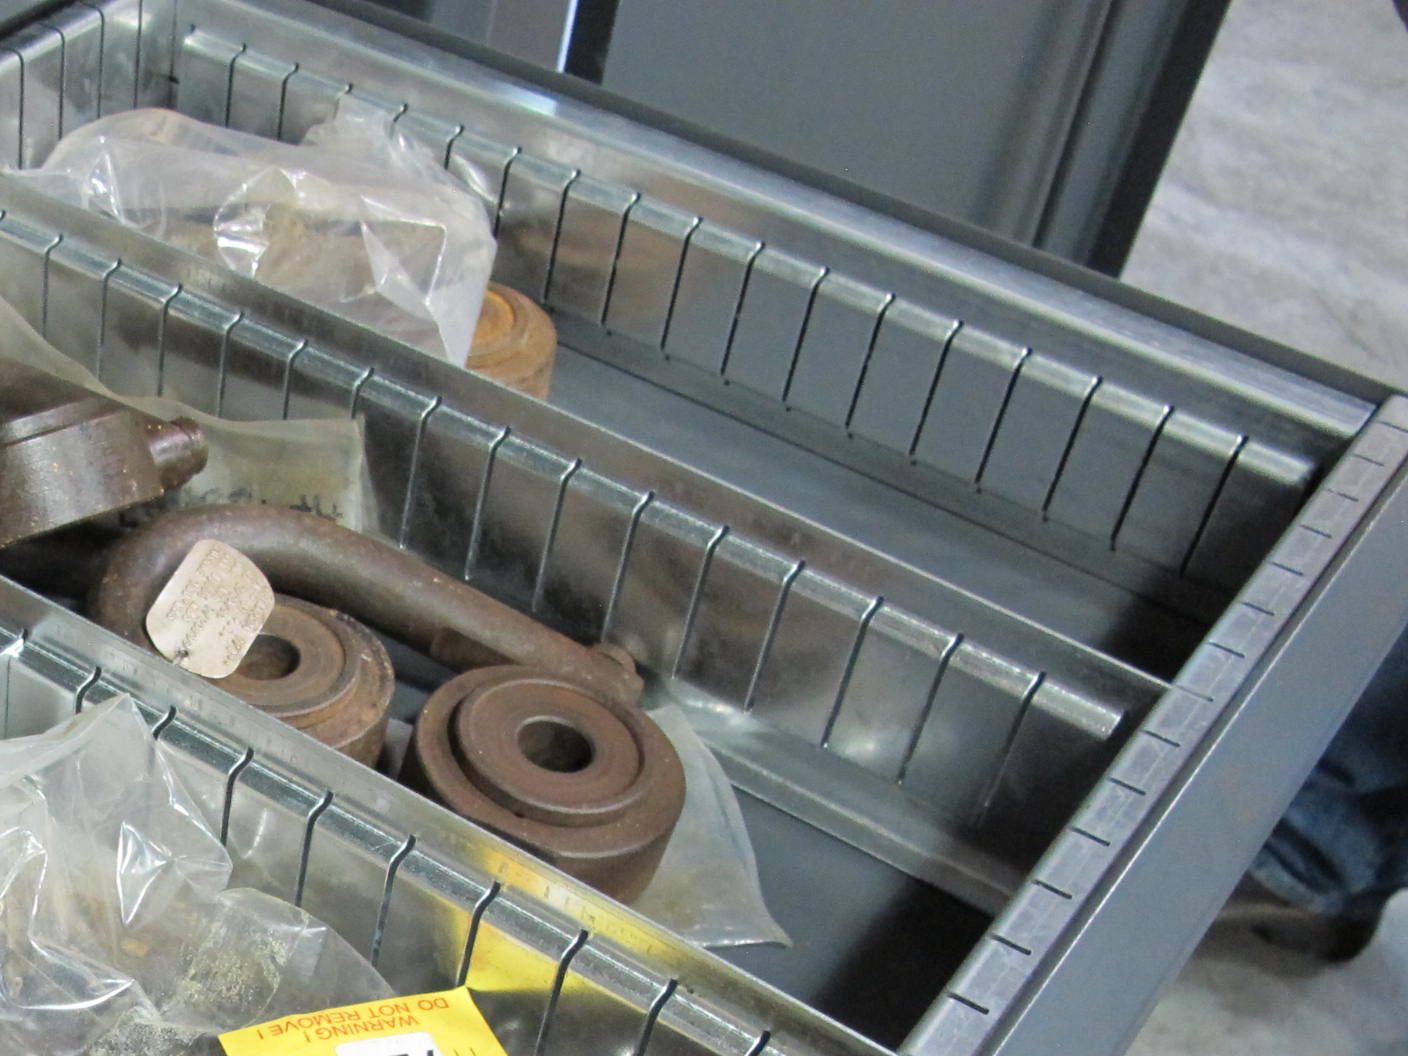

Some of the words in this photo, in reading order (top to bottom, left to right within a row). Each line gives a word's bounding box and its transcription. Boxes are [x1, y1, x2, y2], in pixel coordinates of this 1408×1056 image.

[368, 1002, 411, 1019] NOT
[416, 997, 450, 1011] DO
[267, 1009, 362, 1036] REMOVE
[314, 1014, 419, 1041] WARNING
